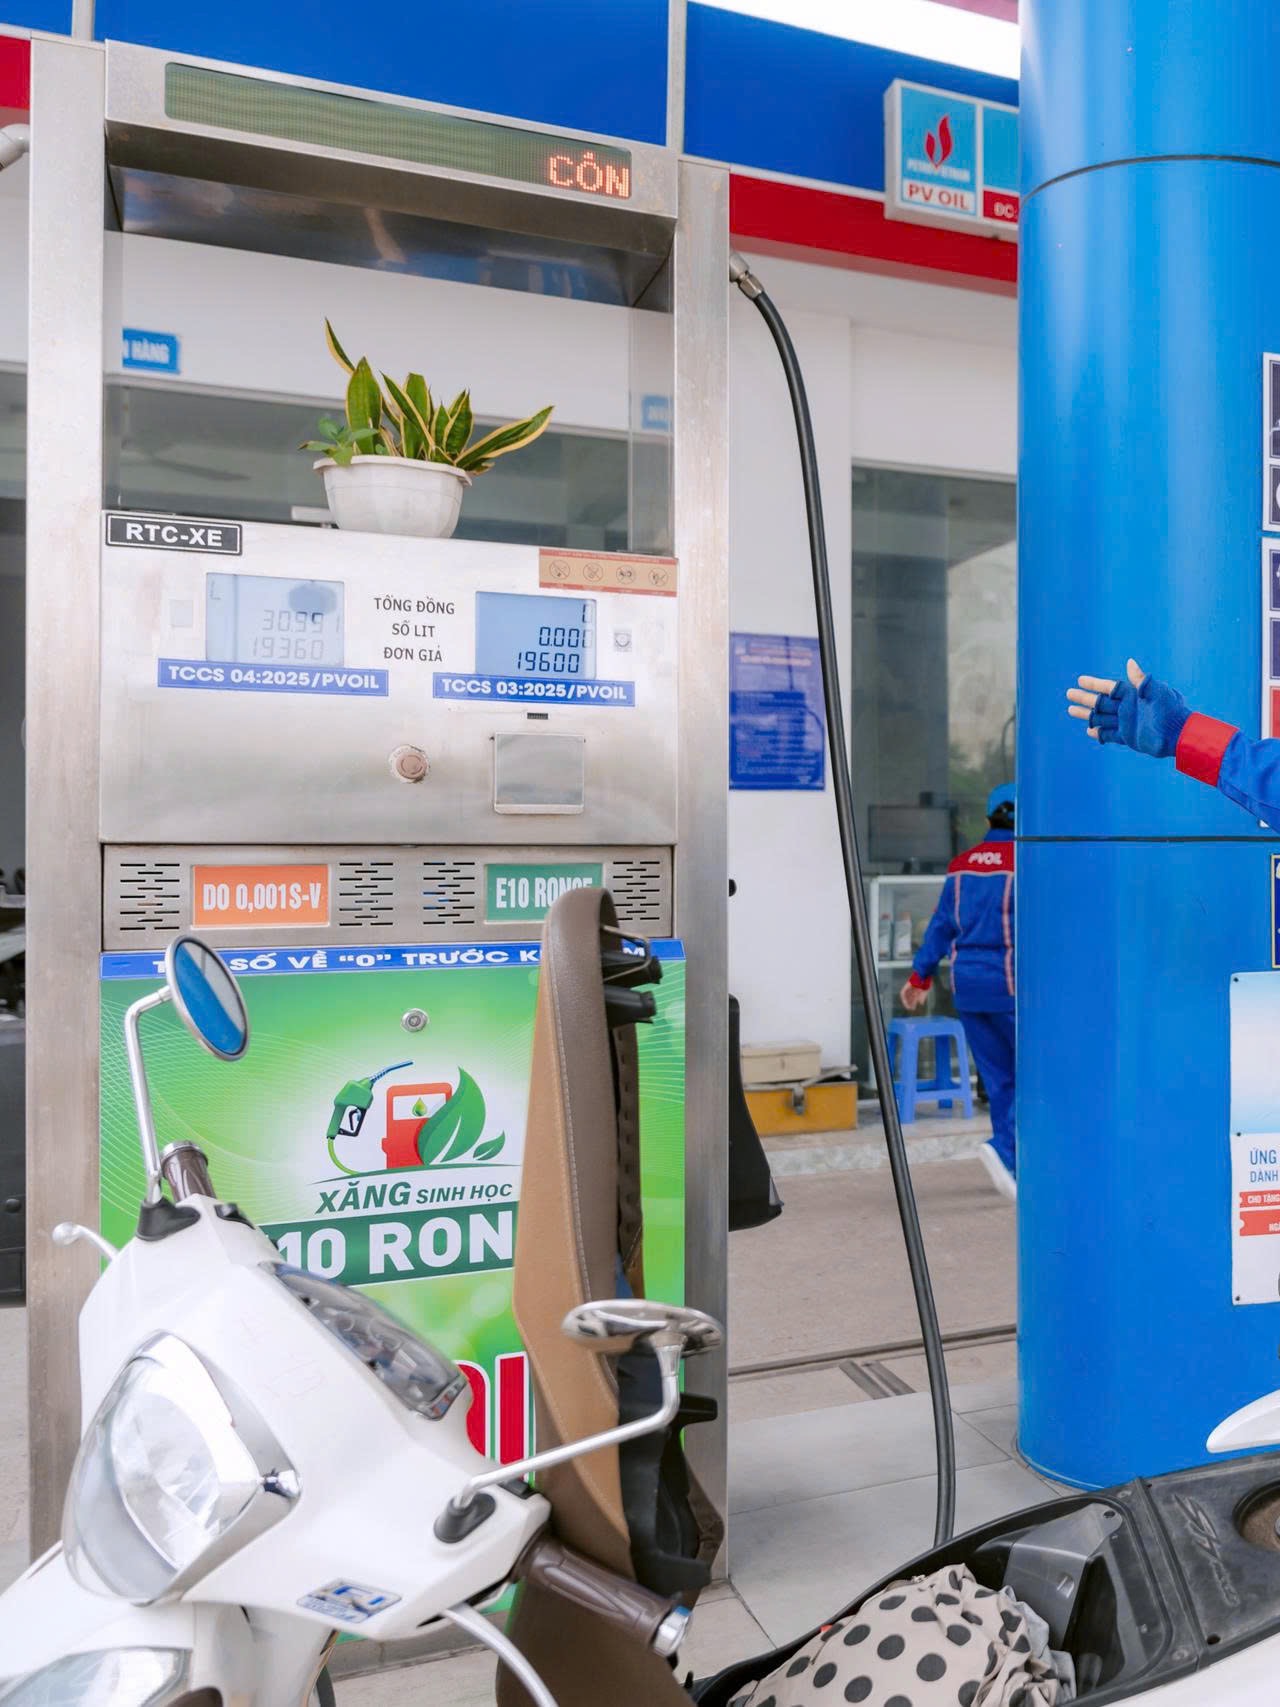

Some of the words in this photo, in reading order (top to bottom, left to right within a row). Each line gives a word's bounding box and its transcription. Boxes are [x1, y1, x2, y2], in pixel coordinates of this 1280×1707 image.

[548, 151, 631, 198] CÔN
[908, 183, 933, 202] PV
[938, 191, 970, 210] OIL
[125, 521, 223, 548] RTC-XE
[414, 625, 436, 638] LIT
[253, 636, 324, 661] 19360
[418, 645, 443, 662] GIÁ
[517, 651, 580, 674] 19600
[168, 665, 227, 684] TCCS
[230, 668, 380, 690] 04:2025/PVOIL
[442, 677, 491, 695] TCCS
[496, 681, 627, 701] 03:2025/PVOIL
[203, 884, 231, 911] DO
[496, 877, 530, 909] E10
[229, 952, 278, 971] SỐ
[287, 950, 328, 970] VỀ
[404, 949, 510, 967] TRƯỚC
[315, 1181, 412, 1214] XĂNG
[415, 1186, 465, 1204] SINH
[469, 1182, 513, 1202] HỌC
[277, 1227, 347, 1281] 10
